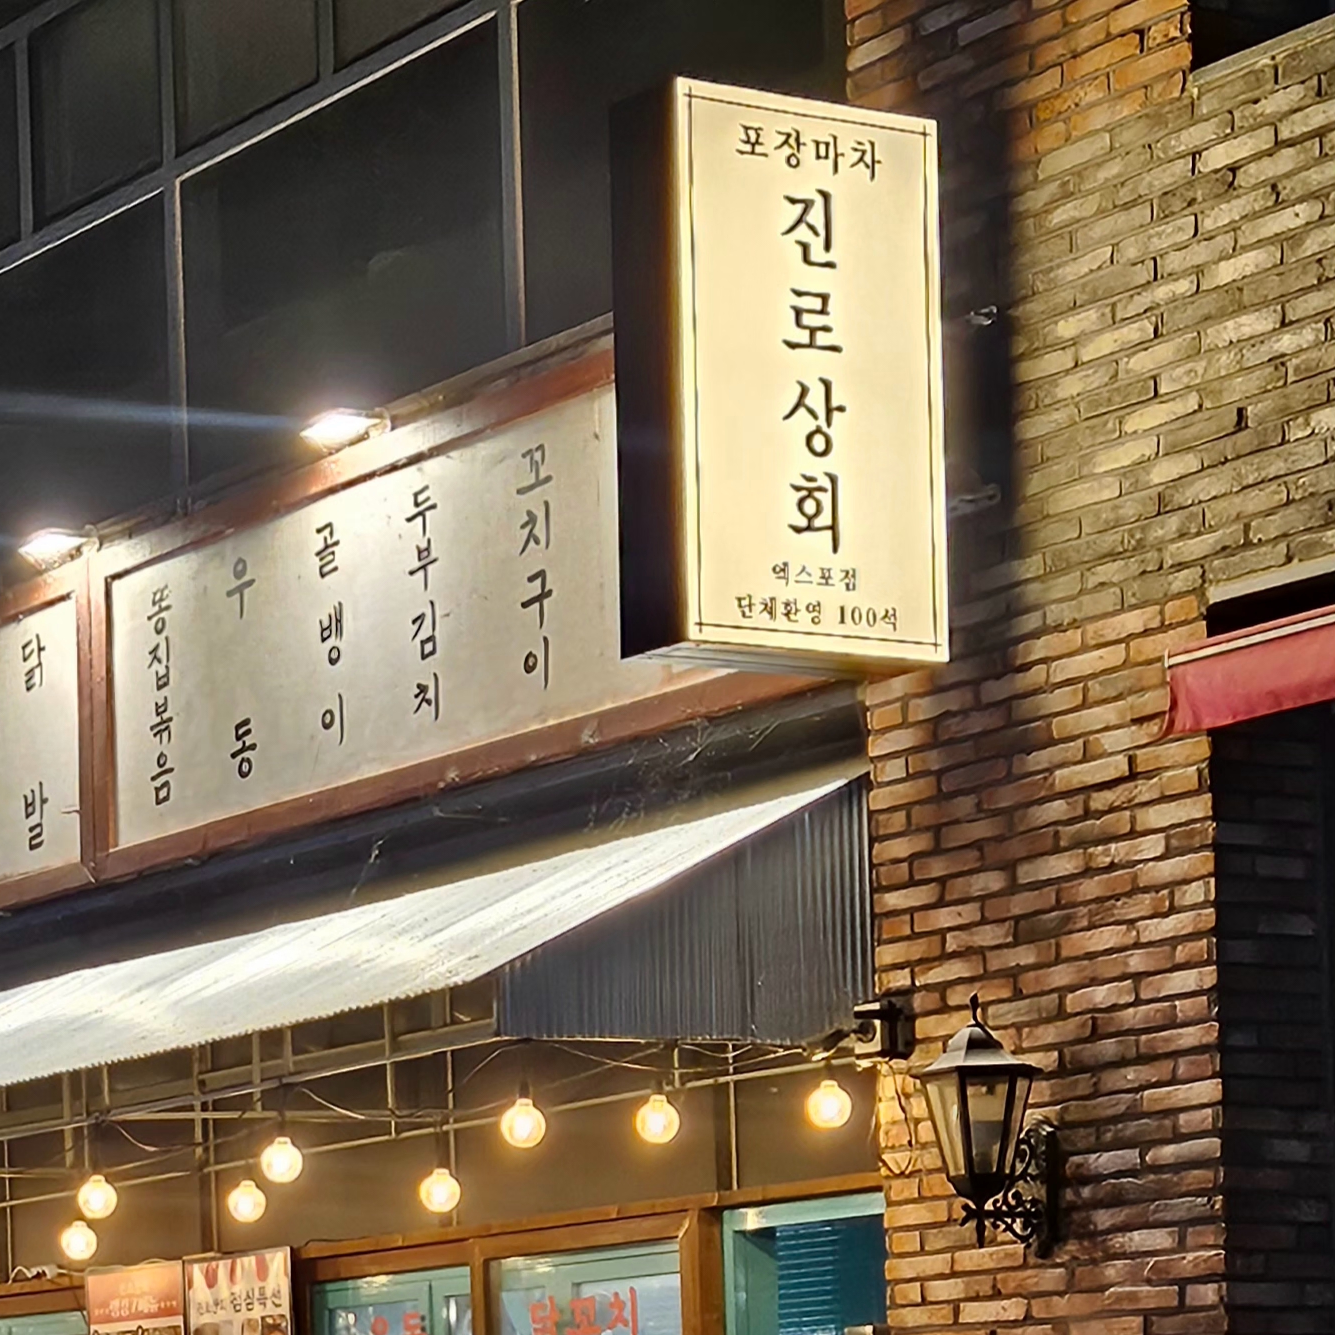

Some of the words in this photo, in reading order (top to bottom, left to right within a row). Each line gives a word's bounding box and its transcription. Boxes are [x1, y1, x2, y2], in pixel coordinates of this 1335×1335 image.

[735, 122, 882, 183] 포장마차
[779, 188, 847, 555] 진로상회
[225, 556, 258, 780] 우동
[314, 521, 345, 746] 골뱅이
[404, 484, 441, 722] 두부김치
[515, 442, 554, 691] 꼬치구이
[735, 593, 822, 625] 단체환영
[837, 605, 898, 632] 100석
[771, 560, 857, 592] 엑스포점
[21, 633, 49, 852] 닭발
[146, 584, 175, 807] 똥집볶음
